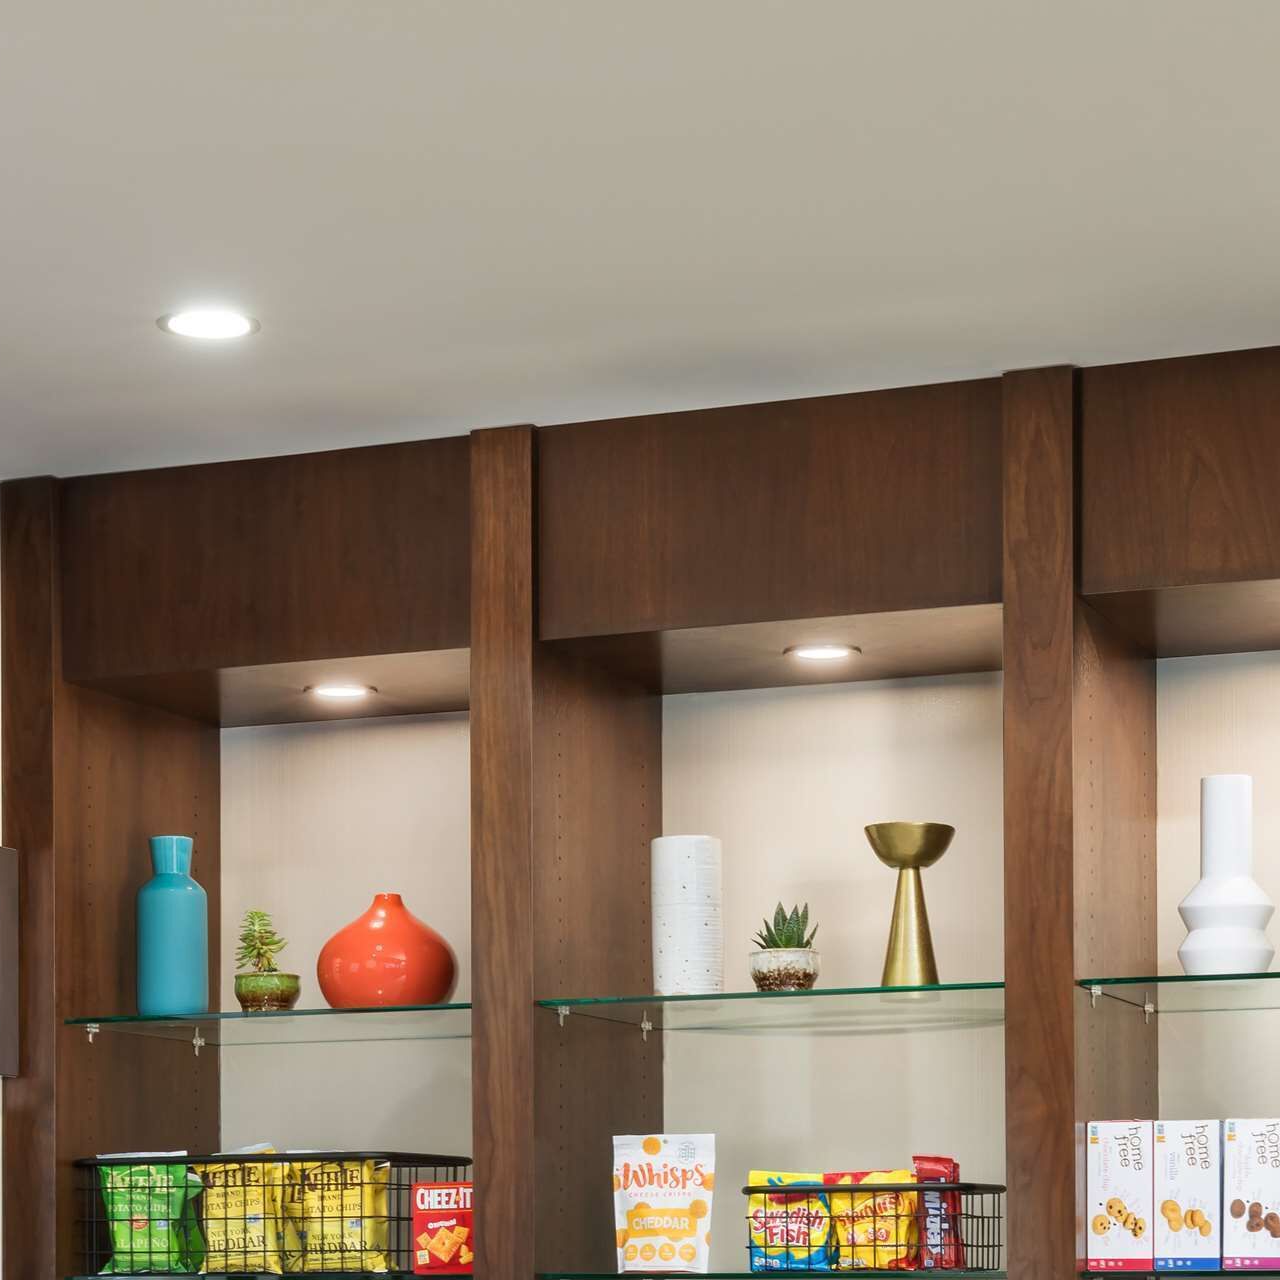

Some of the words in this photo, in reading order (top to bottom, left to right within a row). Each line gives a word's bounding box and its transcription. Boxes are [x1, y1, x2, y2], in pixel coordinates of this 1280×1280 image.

[1114, 1135, 1131, 1168] free
[1128, 1126, 1144, 1171] home
[1181, 1133, 1198, 1167] free
[1194, 1124, 1211, 1170] home
[1251, 1131, 1268, 1166] free
[1265, 1122, 1280, 1169] home
[622, 1162, 705, 1190] Whisps
[632, 1216, 690, 1231] CHEDDAR
[752, 1206, 825, 1232] Swedish
[207, 1234, 267, 1252] HEDDAR
[308, 1240, 368, 1255] HEDDAR
[767, 1225, 809, 1246] Fish
